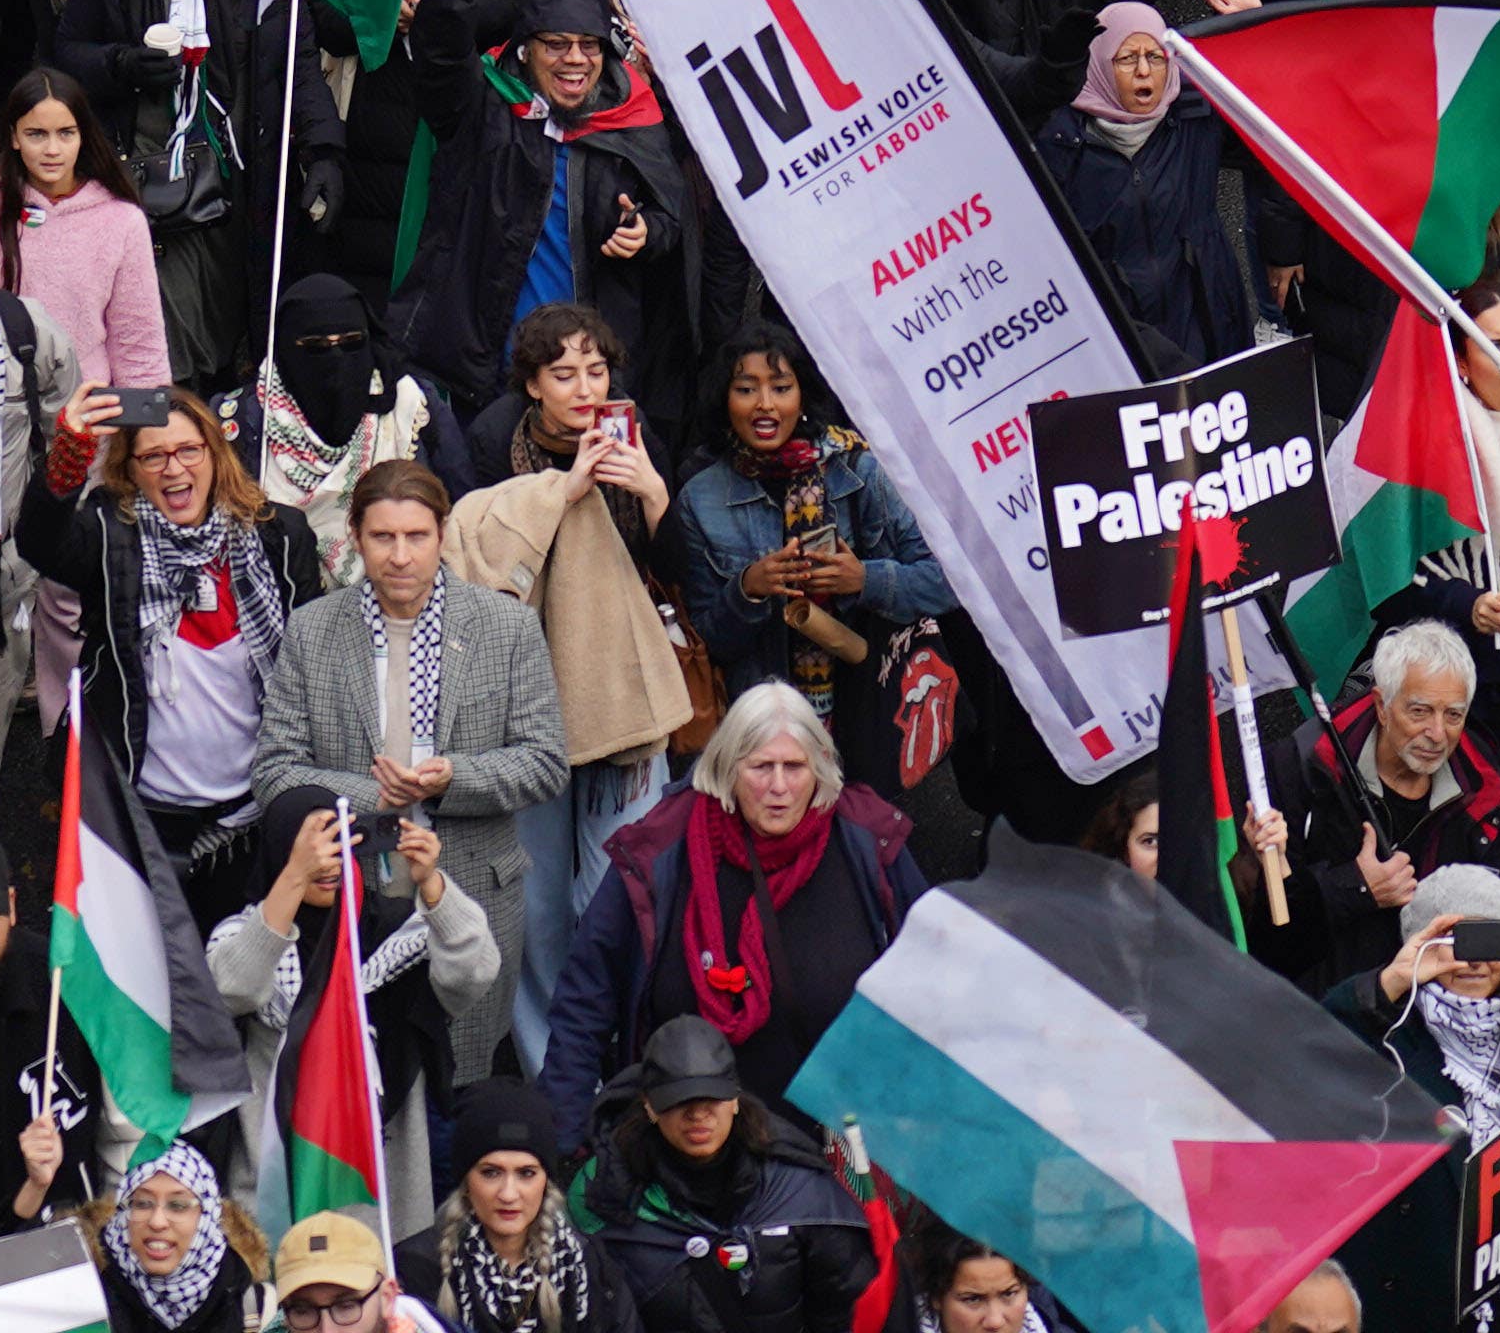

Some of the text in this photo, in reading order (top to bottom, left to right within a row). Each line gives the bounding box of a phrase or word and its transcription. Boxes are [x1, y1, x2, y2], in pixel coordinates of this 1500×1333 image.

[779, 66, 945, 189] JEWISH VOICE
[811, 101, 951, 204] FOR LABOUR
[871, 195, 992, 295] ALWAYS
[893, 255, 1010, 343] with the
[924, 284, 1068, 394] oppressed
[1118, 392, 1249, 467] Free
[1056, 438, 1314, 548] Palestine
